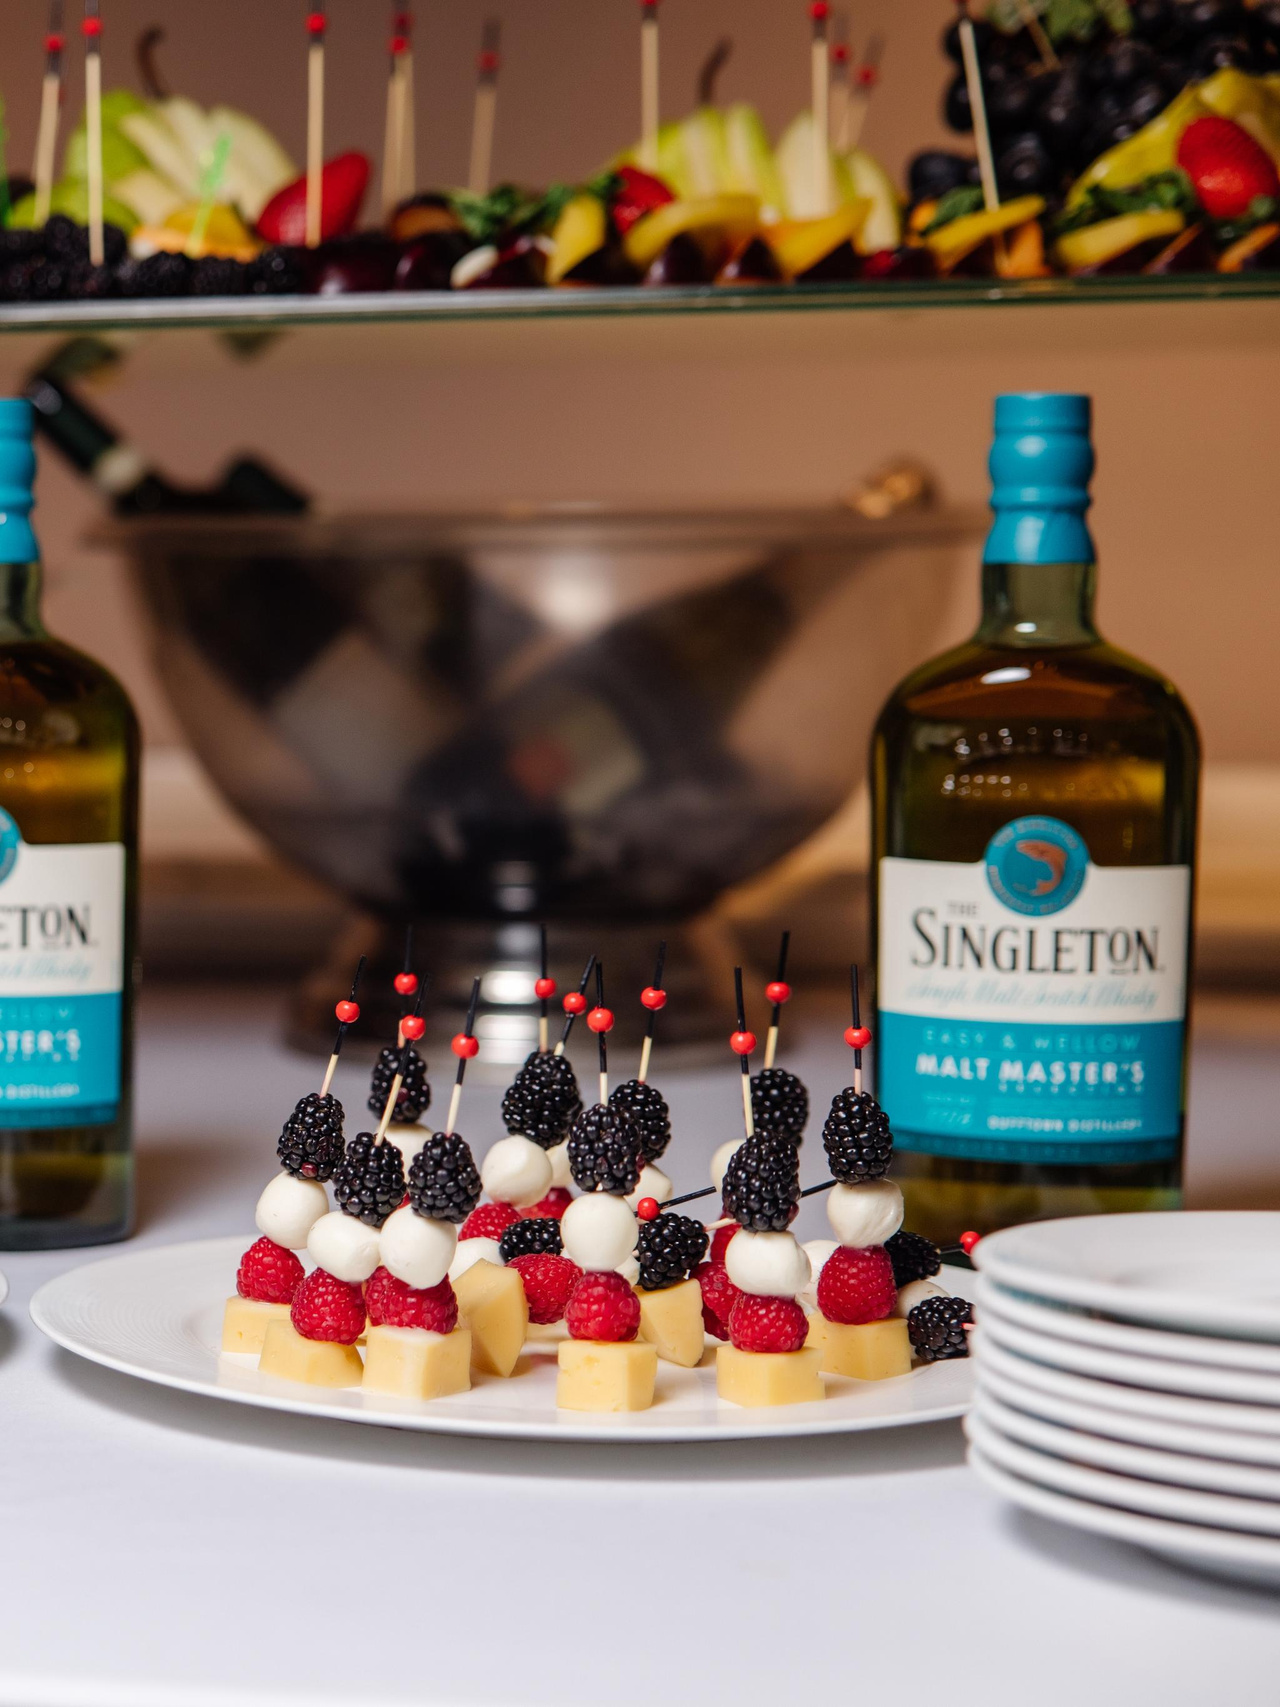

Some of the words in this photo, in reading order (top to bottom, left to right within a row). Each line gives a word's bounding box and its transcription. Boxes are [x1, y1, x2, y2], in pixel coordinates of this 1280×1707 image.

[948, 902, 978, 917] THE
[910, 906, 1160, 974] SINGLETON
[915, 1053, 990, 1081] MALT
[998, 1060, 1144, 1085] MASTER'S
